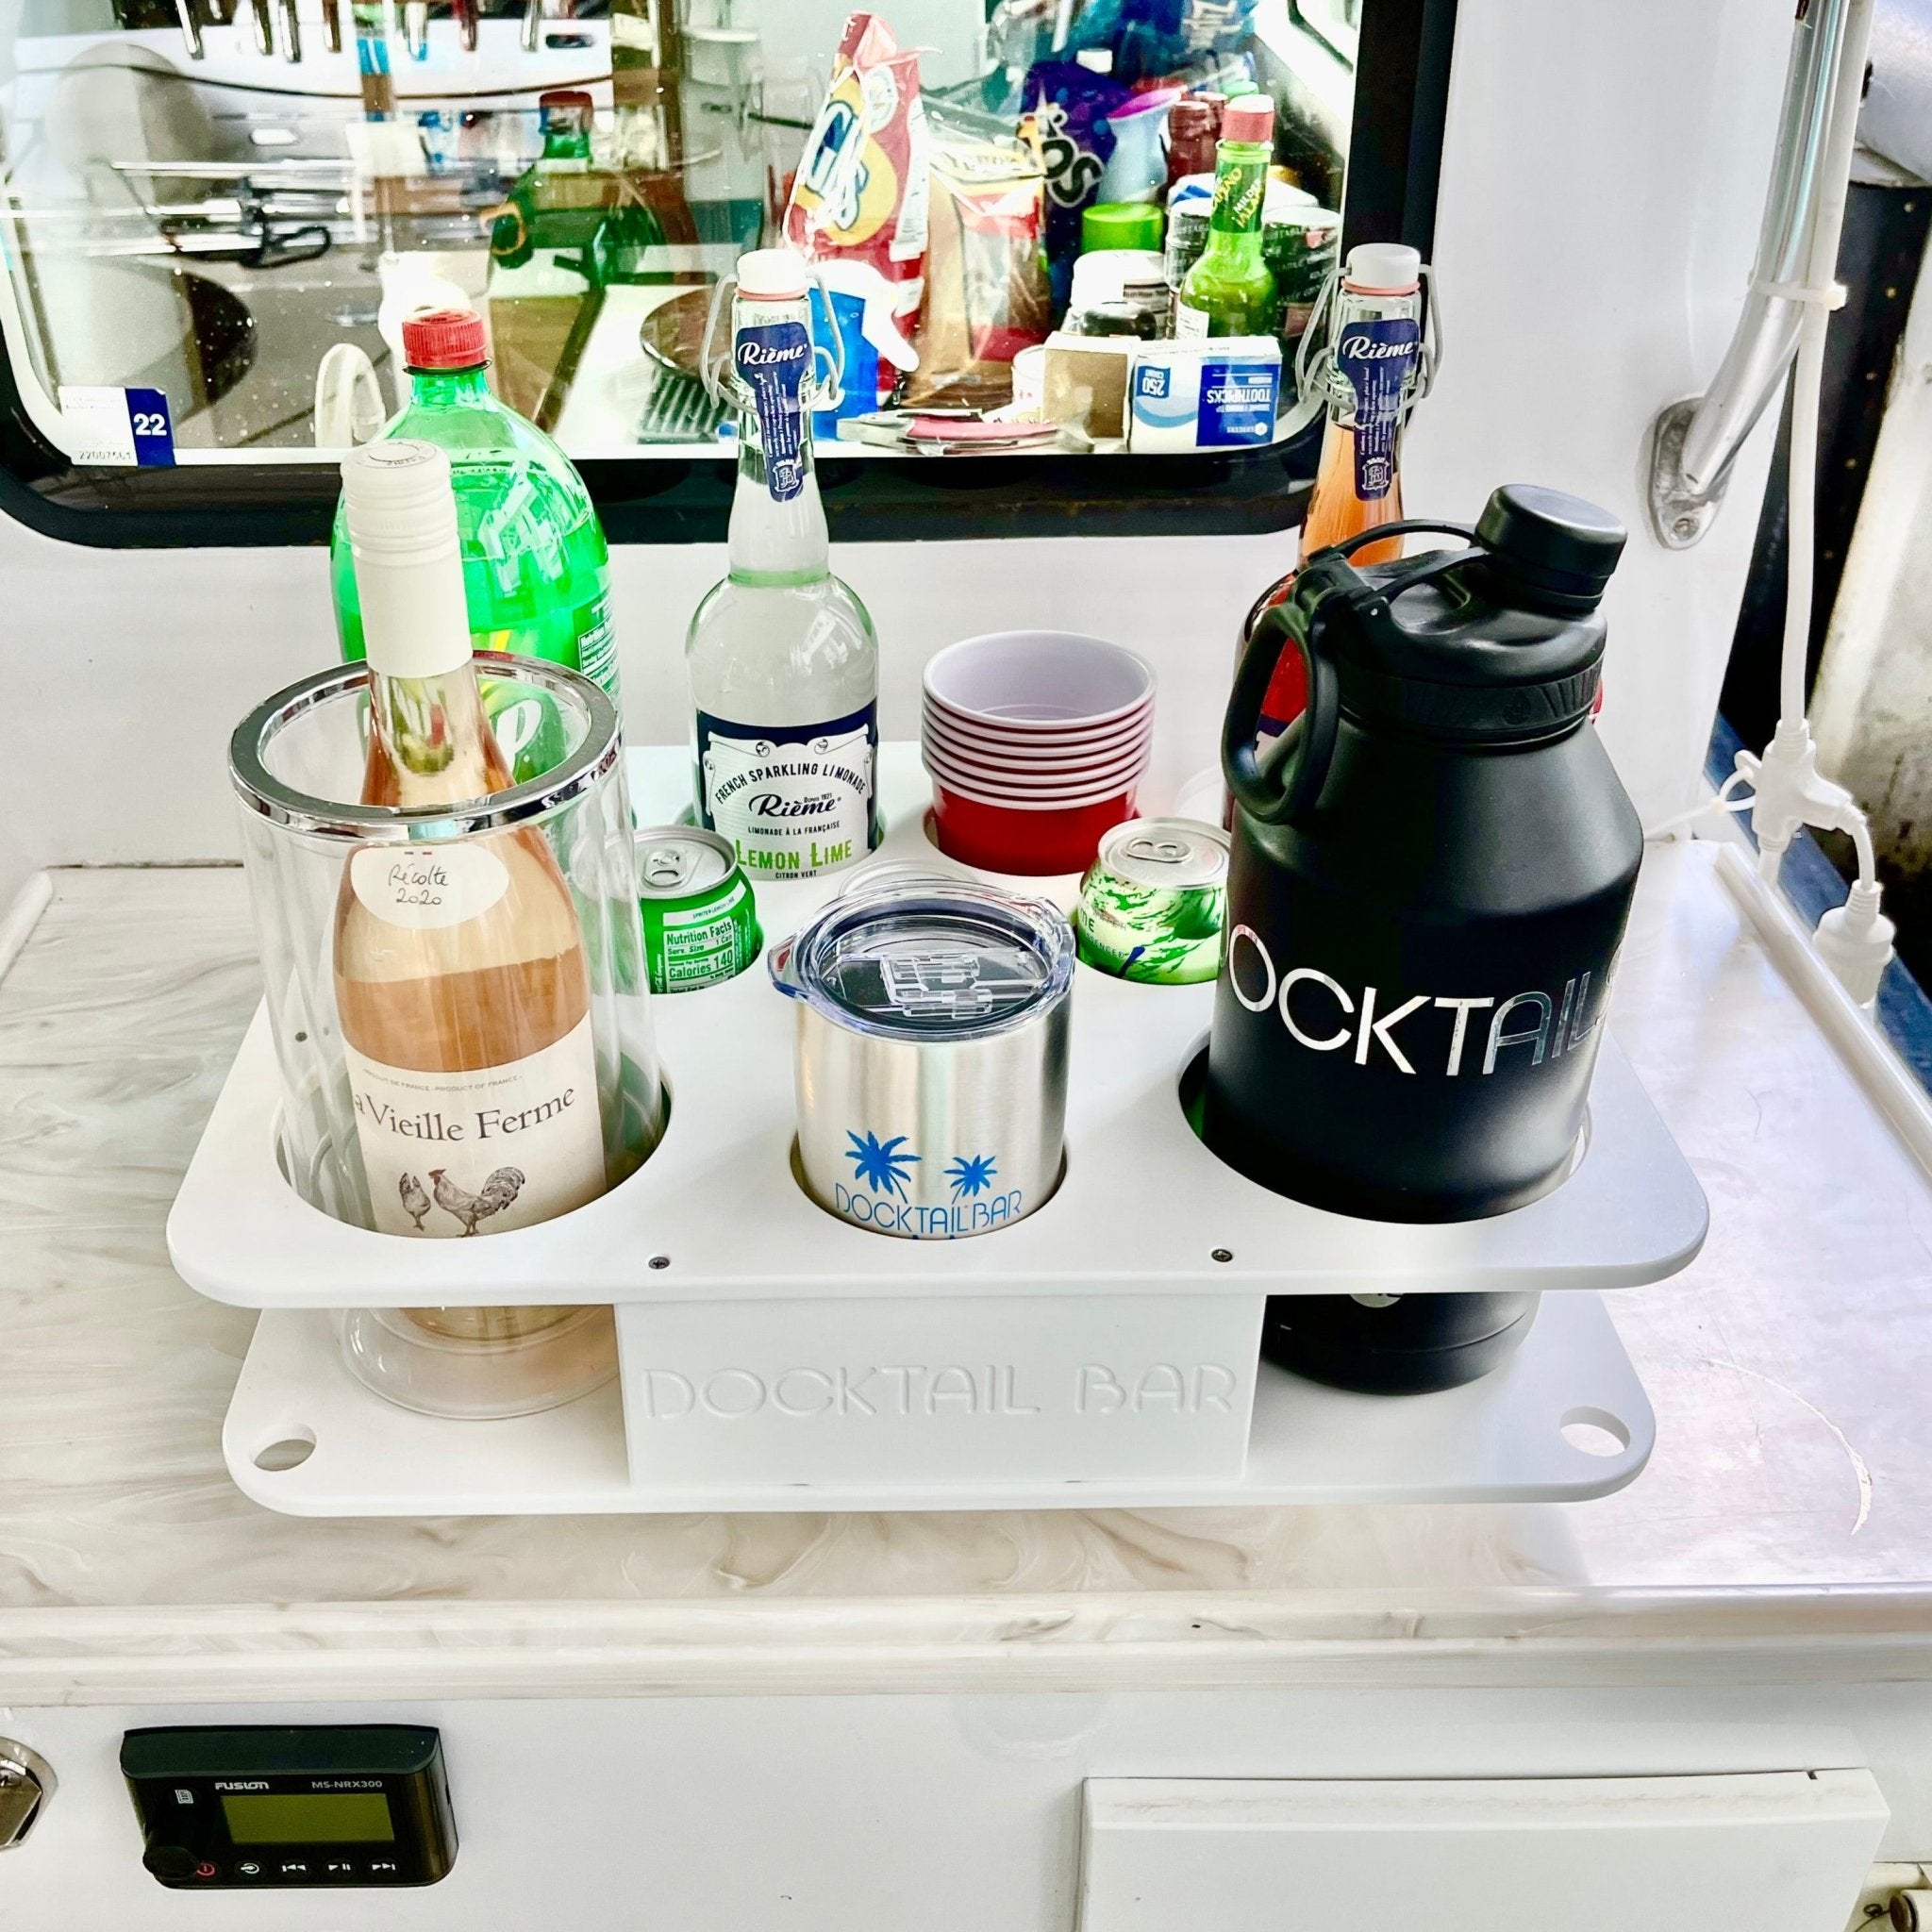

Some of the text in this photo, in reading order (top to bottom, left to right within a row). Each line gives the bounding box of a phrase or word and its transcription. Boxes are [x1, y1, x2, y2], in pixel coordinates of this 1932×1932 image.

[738, 341, 805, 365] Rième
[1342, 336, 1413, 359] Rième
[1142, 377, 1165, 395] 250
[133, 412, 168, 436] 22
[715, 763, 867, 805] FRENCH SPARKLING LIMONADE
[748, 793, 837, 817] Rième
[748, 820, 841, 836] LIMONADE À LA FRANÇAISE
[735, 840, 853, 870] LEMON LIME
[388, 862, 449, 887] Récolte
[395, 887, 442, 906] 2020
[667, 922, 732, 945] Nutrition Facts
[690, 944, 705, 953] Size
[721, 934, 733, 942] Can
[669, 949, 733, 978] Calories 140
[1228, 924, 1601, 1075] OCKTAIL
[401, 1082, 430, 1091] FRANCE
[435, 1084, 474, 1092] PRODUCT
[488, 1075, 518, 1087] FRANCE
[355, 1088, 575, 1141] a Vieille Ferme
[973, 1190, 1023, 1230] BAR
[642, 1362, 1238, 1419] DOCKTAIL BAR
[215, 1780, 383, 1790] FUSION MS-NRX300
